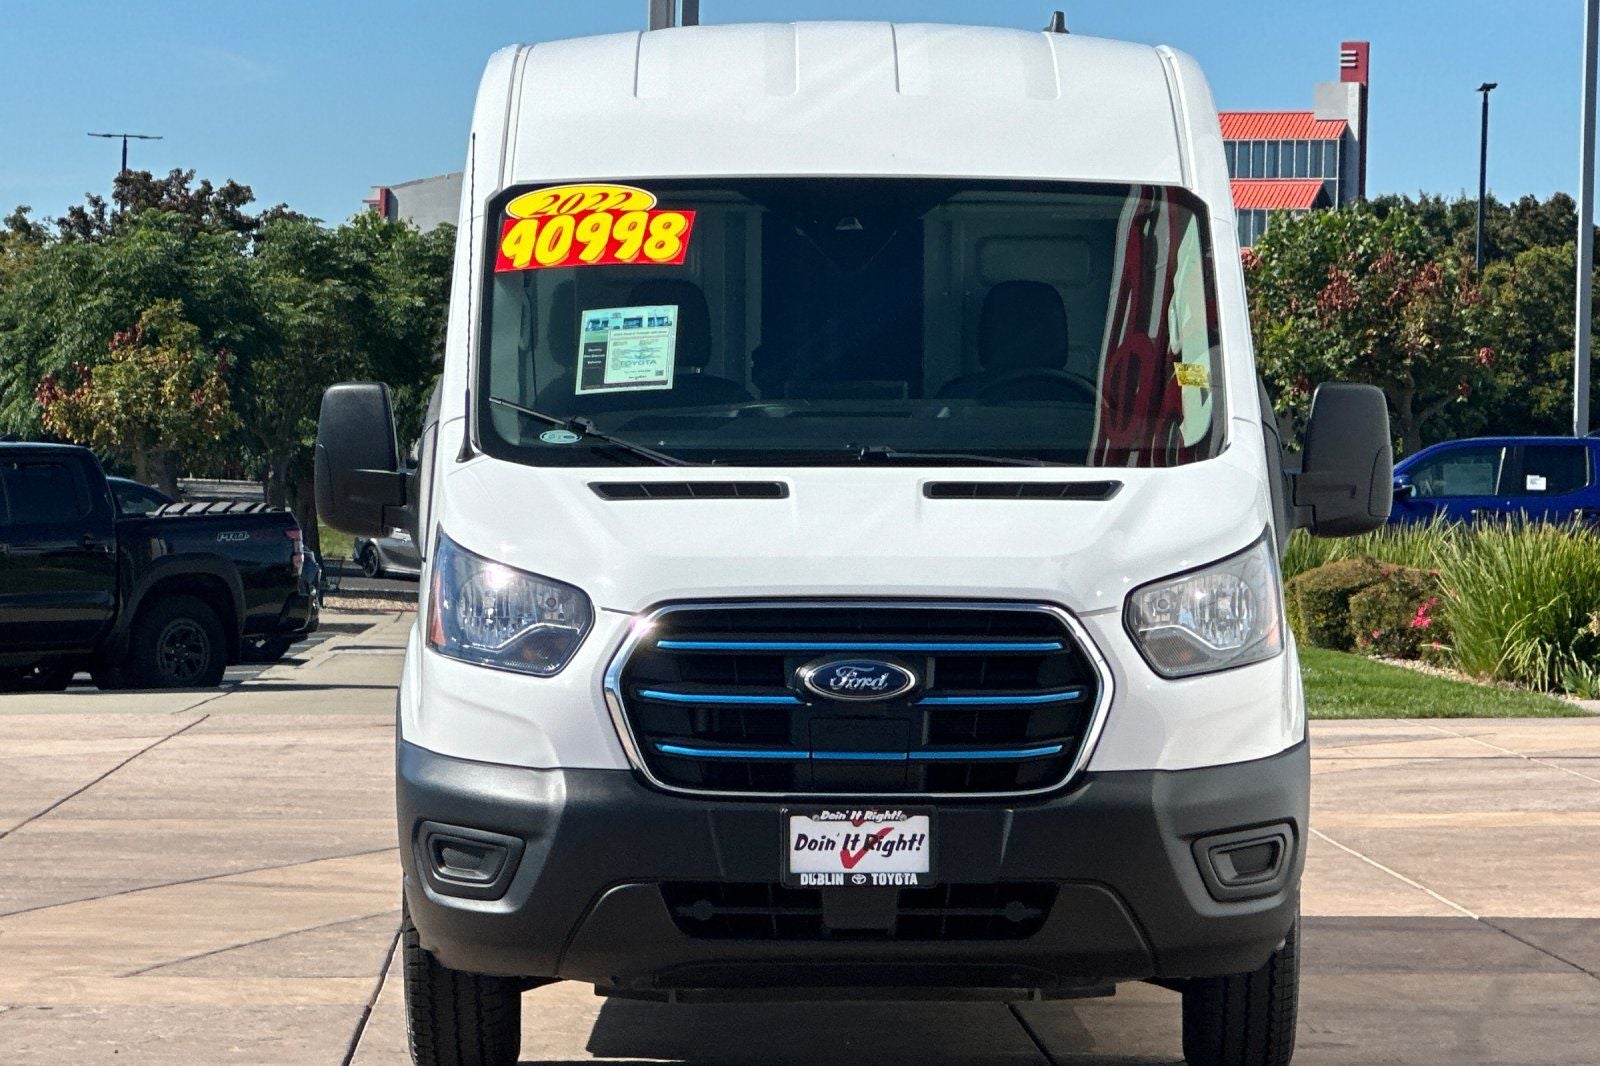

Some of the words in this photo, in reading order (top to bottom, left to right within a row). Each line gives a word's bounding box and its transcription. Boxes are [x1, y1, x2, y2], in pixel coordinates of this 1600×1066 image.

[529, 191, 633, 216] 2022
[501, 210, 689, 269] 40998
[830, 665, 889, 690] Ford
[820, 810, 849, 821] Doin'
[850, 810, 863, 820] It
[864, 810, 902, 823] Right!
[794, 833, 840, 850] Doin'
[842, 833, 860, 850] It
[864, 833, 926, 857] Right!
[800, 873, 845, 886] DUBLIN
[870, 873, 918, 886] TOYOTA
